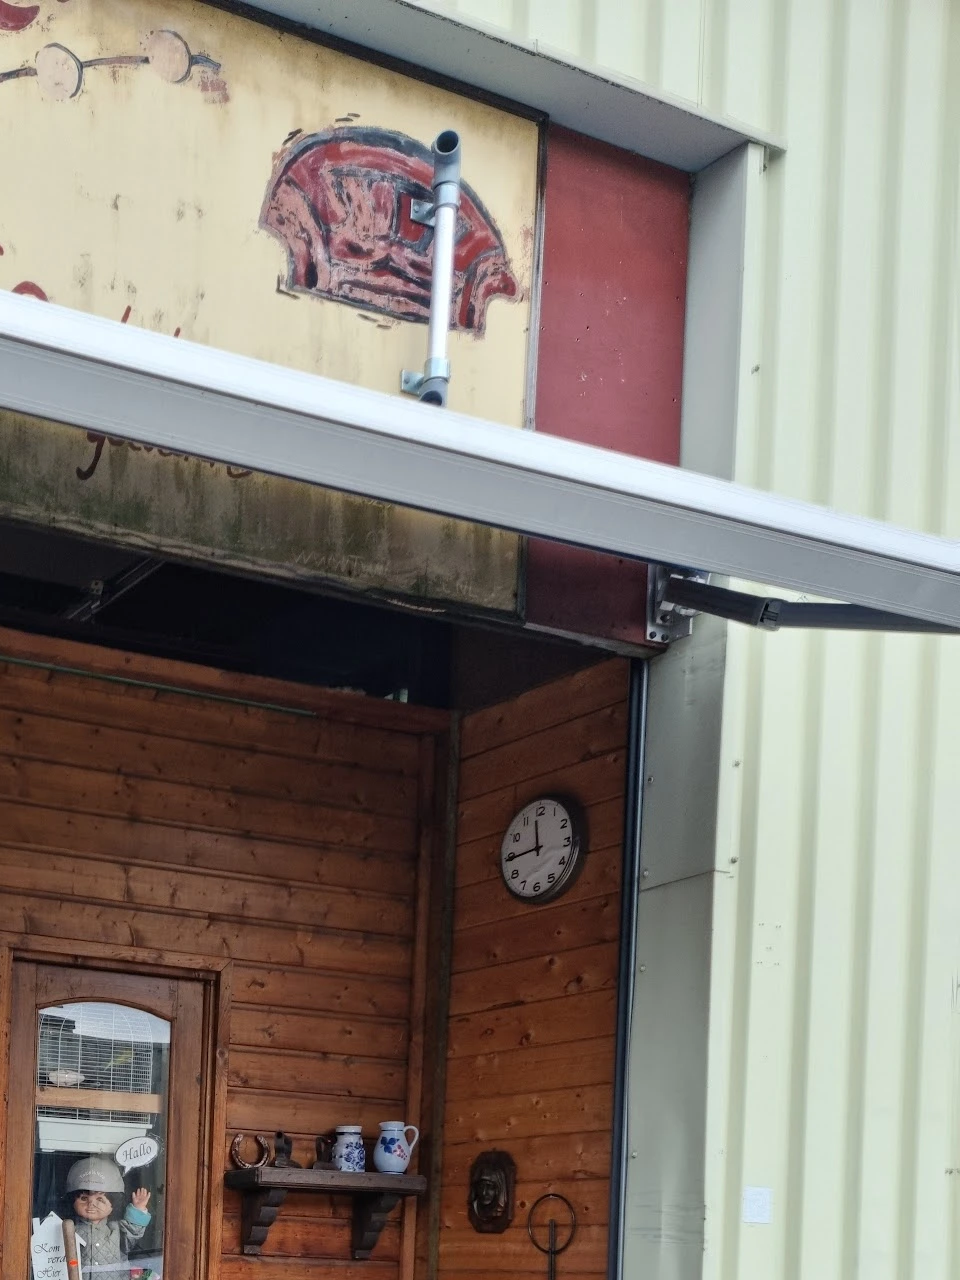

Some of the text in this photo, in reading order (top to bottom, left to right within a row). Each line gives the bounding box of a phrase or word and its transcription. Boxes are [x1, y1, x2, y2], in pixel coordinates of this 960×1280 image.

[560, 819, 568, 829] 2
[563, 837, 571, 847] 3
[559, 856, 566, 865] 4
[511, 870, 519, 879] 8
[547, 873, 555, 883] 5
[520, 880, 527, 890] 7
[533, 882, 541, 892] 6
[122, 1142, 152, 1163] Hallo
[33, 1243, 61, 1254] Kom
